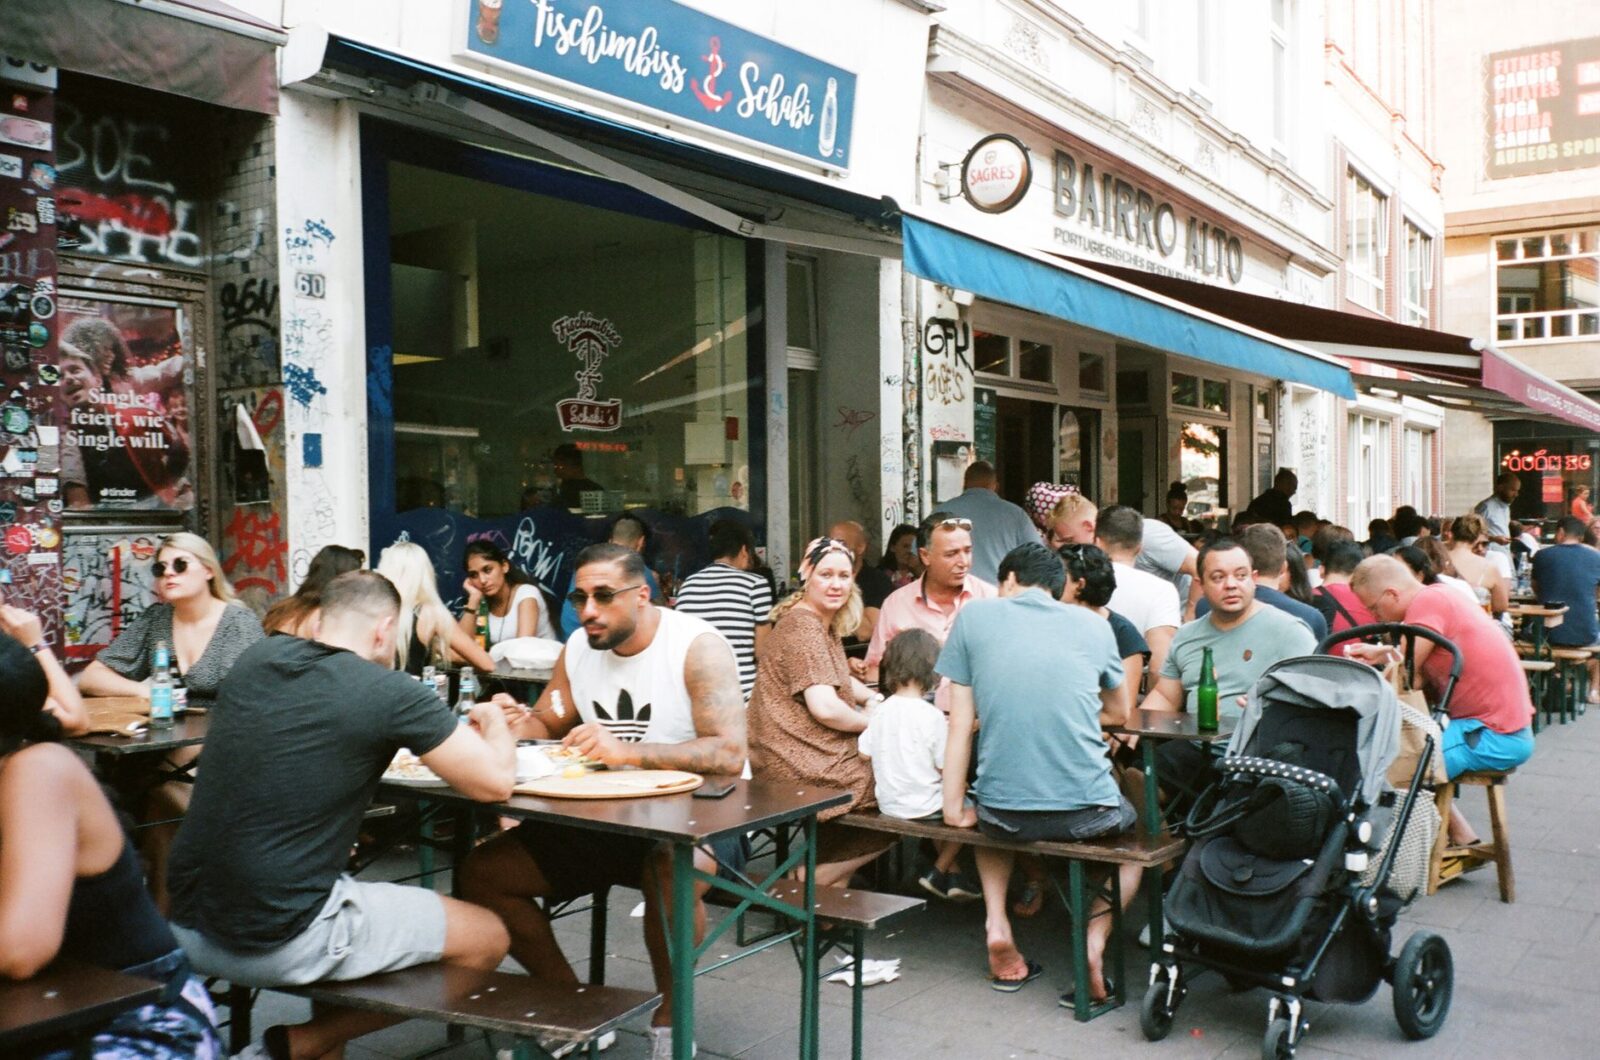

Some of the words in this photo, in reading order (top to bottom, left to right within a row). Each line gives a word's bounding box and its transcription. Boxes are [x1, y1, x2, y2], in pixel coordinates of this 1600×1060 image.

[530, 0, 687, 94] Fischimbiss
[736, 61, 815, 130] Schabi
[1494, 51, 1562, 75] FITNESS
[1494, 66, 1558, 90] CARDIO
[1495, 81, 1561, 104] PILATES
[1494, 99, 1539, 119] YOGA
[1495, 112, 1553, 133] ZUMBA
[1495, 127, 1551, 149] SAUNA
[969, 164, 1016, 187] SAGRES
[1052, 149, 1177, 258] BAIRRO
[1185, 216, 1244, 286] ALTO
[1053, 227, 1145, 270] PORTUGIESISCHES
[297, 273, 325, 297] 60
[552, 311, 622, 348] Fischimbiss
[88, 387, 147, 409] Single
[71, 408, 128, 428] feiert,
[132, 410, 164, 428] wie
[65, 429, 126, 451] Single
[129, 431, 170, 449] will.
[109, 488, 137, 497] tinder
